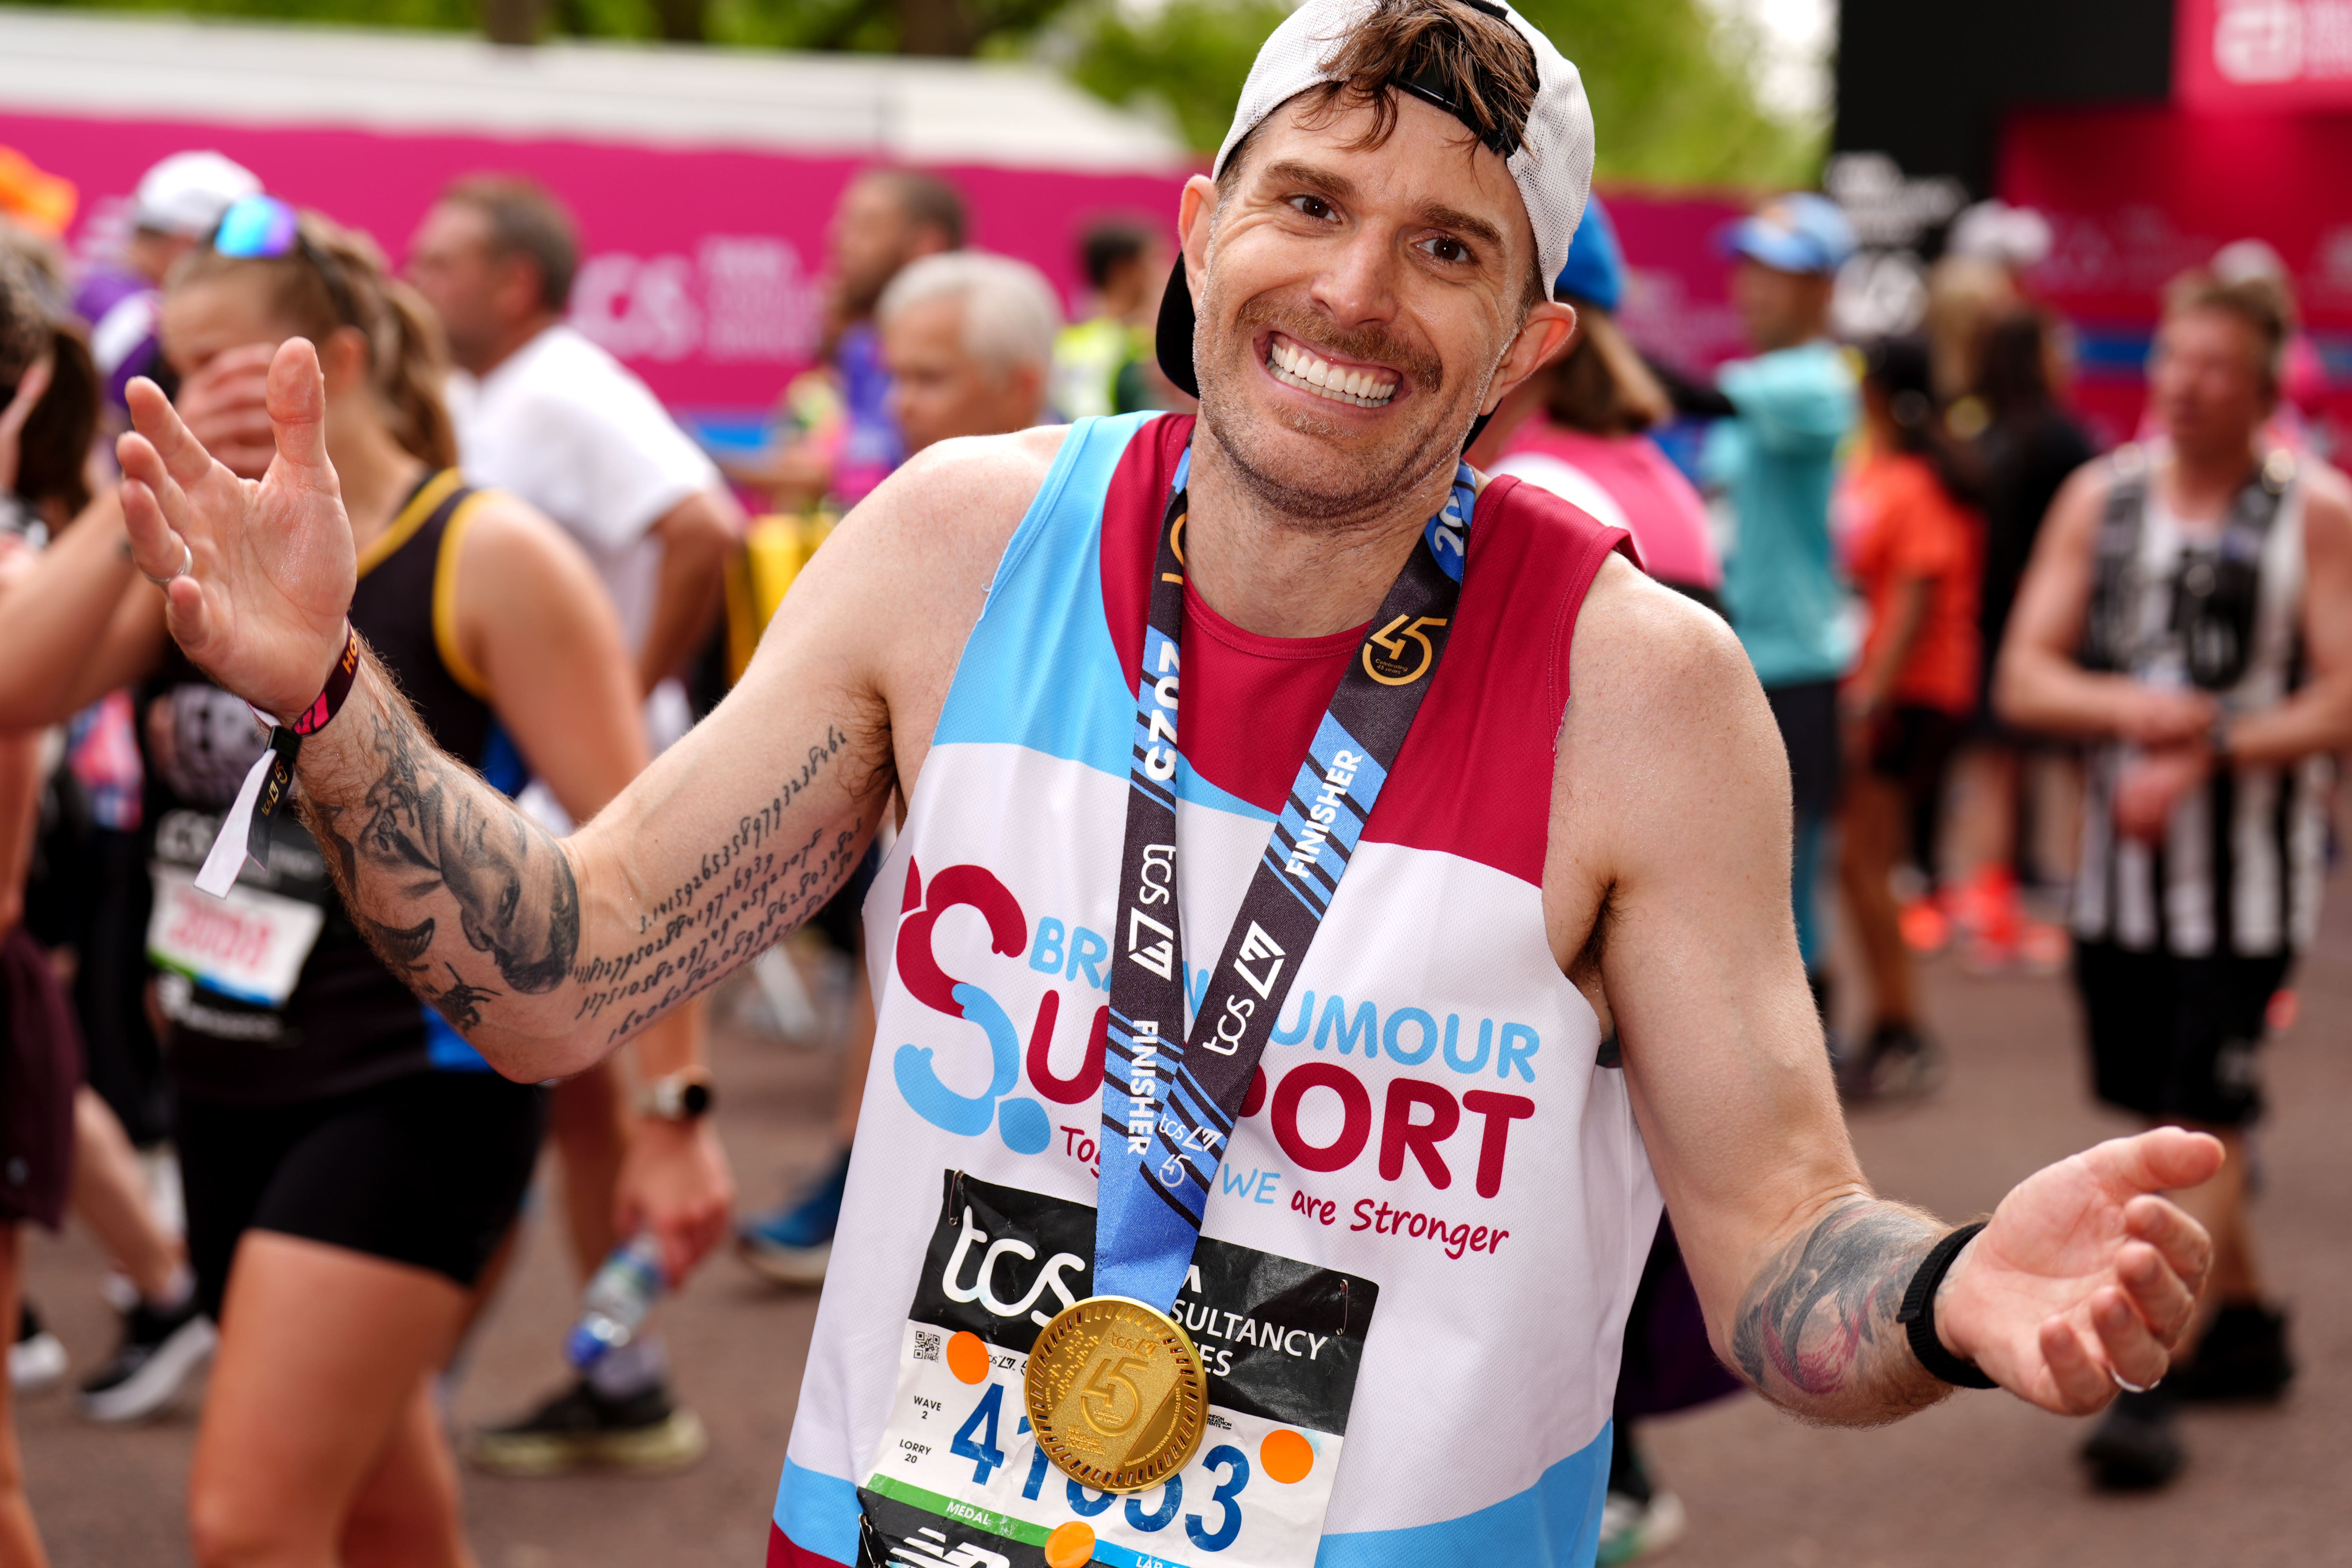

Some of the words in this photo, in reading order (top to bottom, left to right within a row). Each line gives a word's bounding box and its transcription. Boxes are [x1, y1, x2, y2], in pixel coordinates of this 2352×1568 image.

[1375, 658, 1408, 672] Celebrating
[1285, 750, 1363, 878] FINISHER
[1029, 916, 1209, 1020] BRN
[1269, 990, 1540, 1083] UMOUR
[1127, 1020, 1159, 1155] FINISHER
[1223, 1163, 1281, 1204] WE
[1291, 1190, 1336, 1225] are
[1350, 1198, 1509, 1260] Stronger
[1171, 1299, 1328, 1361] SULTANCY
[913, 1395, 942, 1411] WAVE
[921, 1410, 928, 1419] 2
[1166, 1413, 1179, 1436] LONDON
[1207, 1417, 1232, 1427] ARATHON
[899, 1439, 932, 1455] LORRY
[904, 1453, 918, 1464] 20
[1145, 1435, 1169, 1459] MARATHON
[946, 1501, 992, 1526] MEDAL
